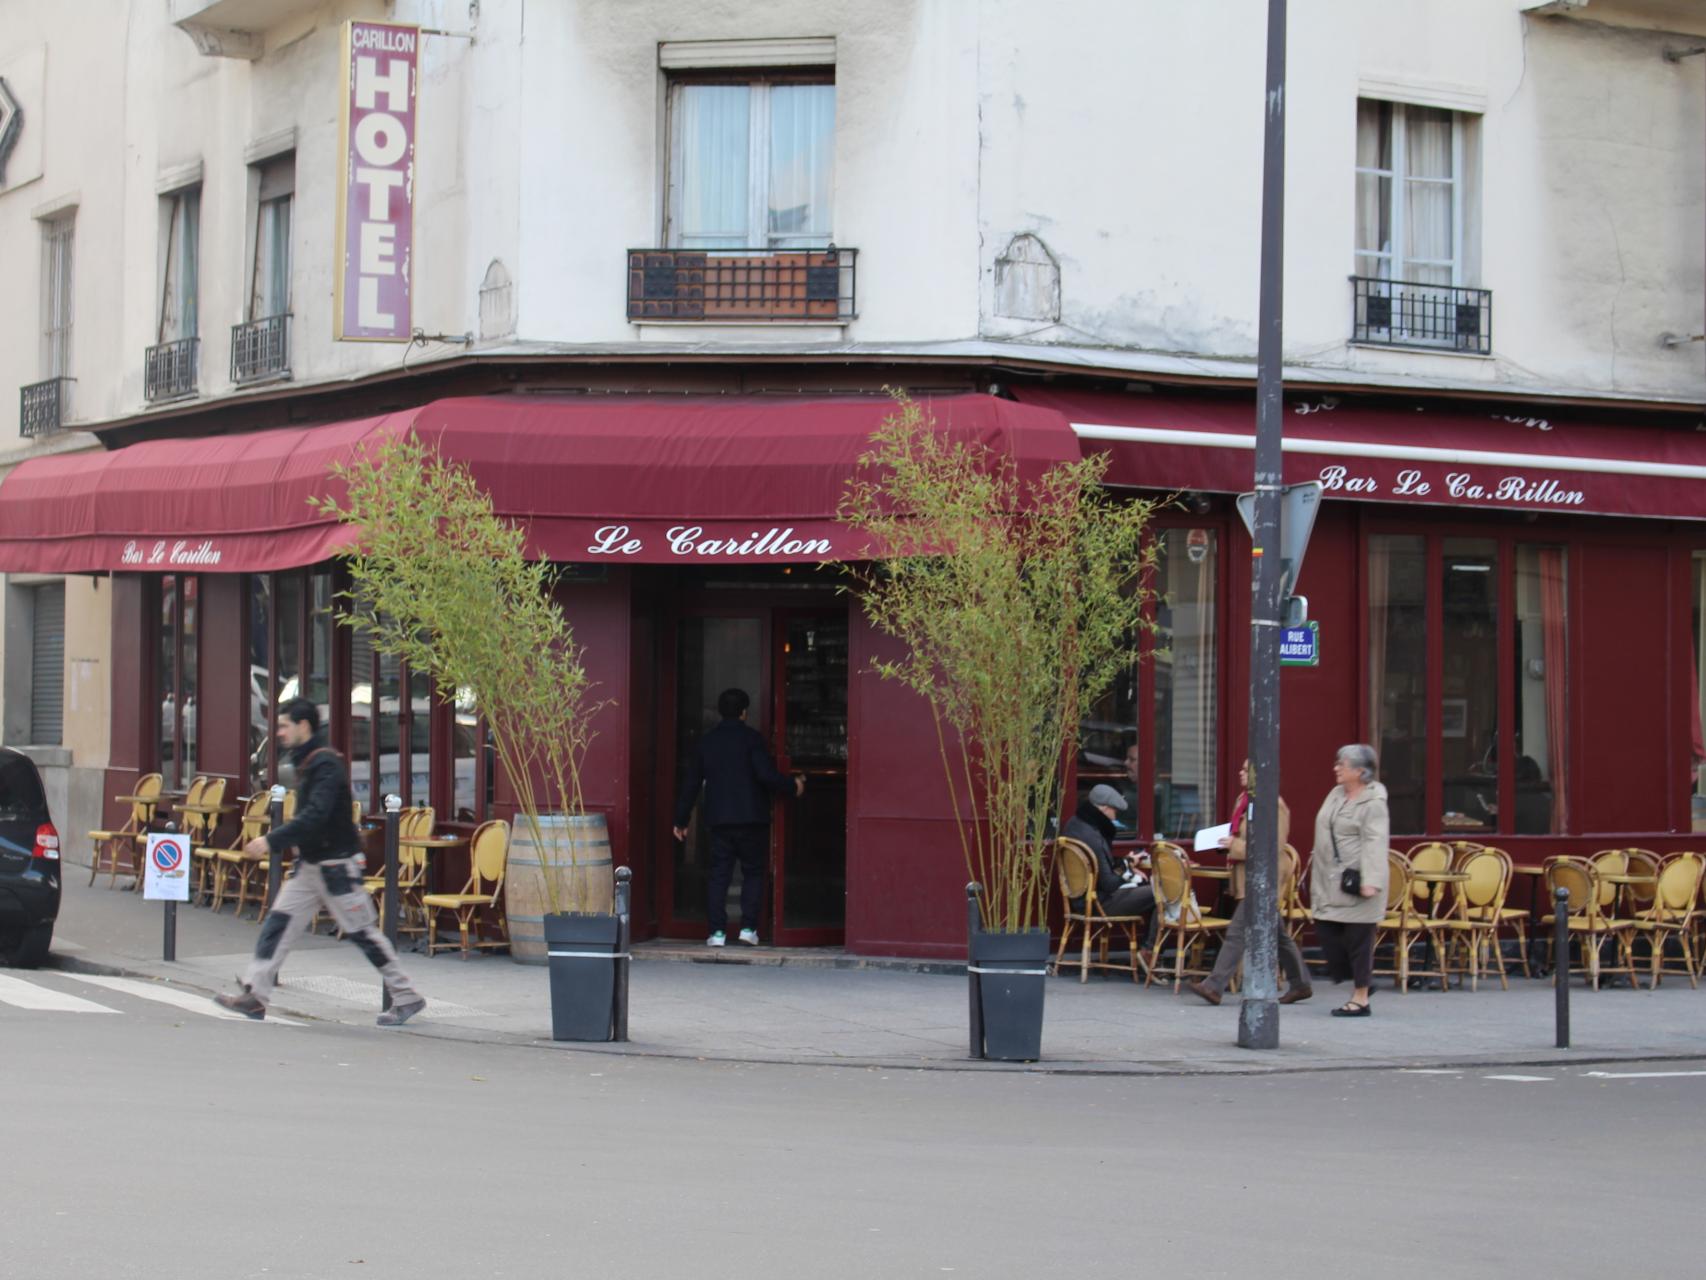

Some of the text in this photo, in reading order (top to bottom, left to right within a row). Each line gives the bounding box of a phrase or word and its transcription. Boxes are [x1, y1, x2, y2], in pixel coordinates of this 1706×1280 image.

[352, 27, 416, 53] CARILLON
[354, 55, 409, 329] HOTEL
[1318, 465, 1378, 493] Bar
[1392, 469, 1431, 496] Le
[121, 540, 221, 565] Bar Le Carillon
[587, 525, 832, 555] Le Carillon
[1280, 643, 1312, 656] ALIBERT
[1288, 631, 1305, 643] RUE
